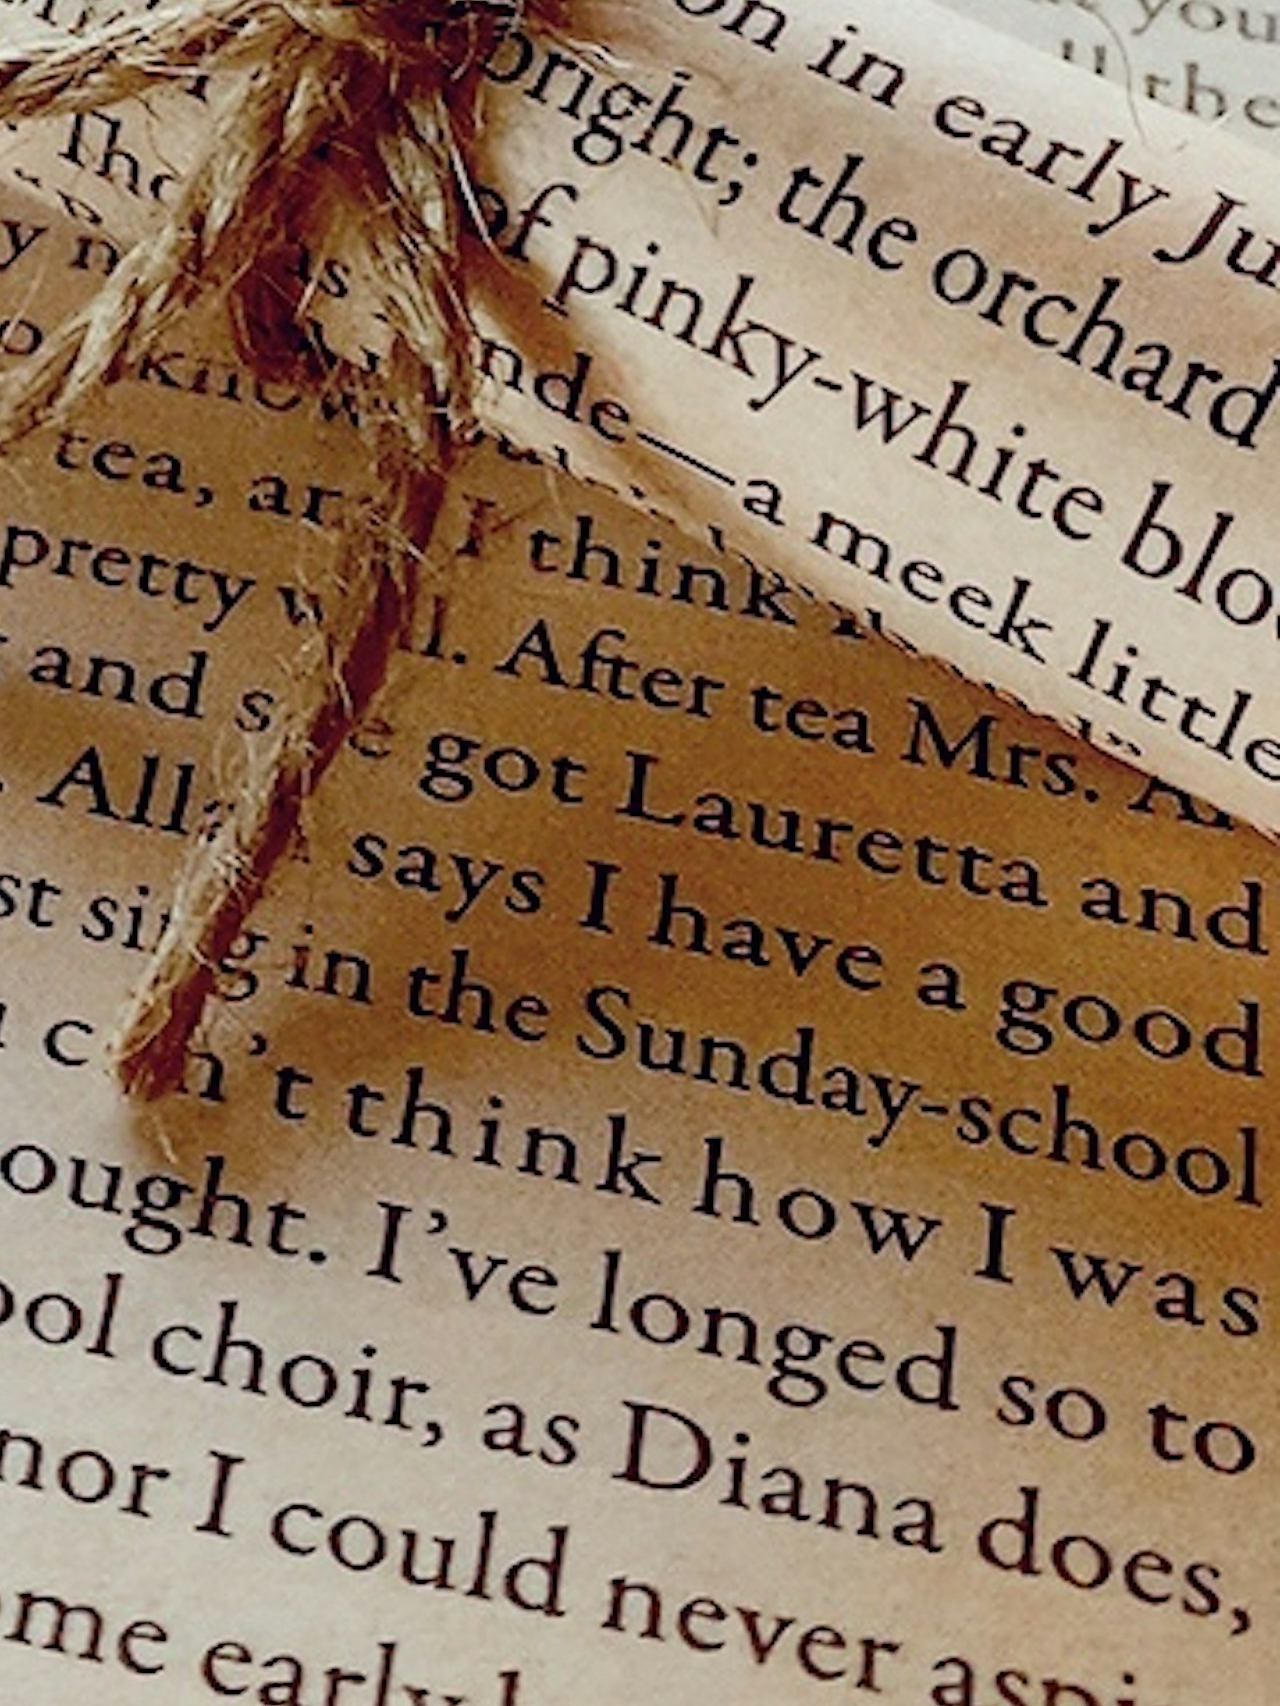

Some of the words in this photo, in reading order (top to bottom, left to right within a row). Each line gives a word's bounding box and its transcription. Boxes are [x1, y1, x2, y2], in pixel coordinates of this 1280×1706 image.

[806, 24, 905, 109] in
[934, 95, 1170, 237] early
[543, 234, 1108, 544] pinky-white
[777, 153, 918, 271] the
[932, 249, 1280, 450] orchard
[810, 511, 1052, 663] meek
[346, 833, 546, 923] says
[578, 860, 621, 934] I
[647, 873, 883, 991] have
[916, 963, 966, 1011] a
[996, 980, 1264, 1077] good
[419, 734, 588, 803] got
[614, 751, 1047, 907] Lauretta
[1081, 878, 1269, 956] and
[150, 1300, 444, 1448] choir,
[481, 1402, 581, 1467] as
[611, 1399, 945, 1554] Diana
[976, 1485, 1252, 1637] does,
